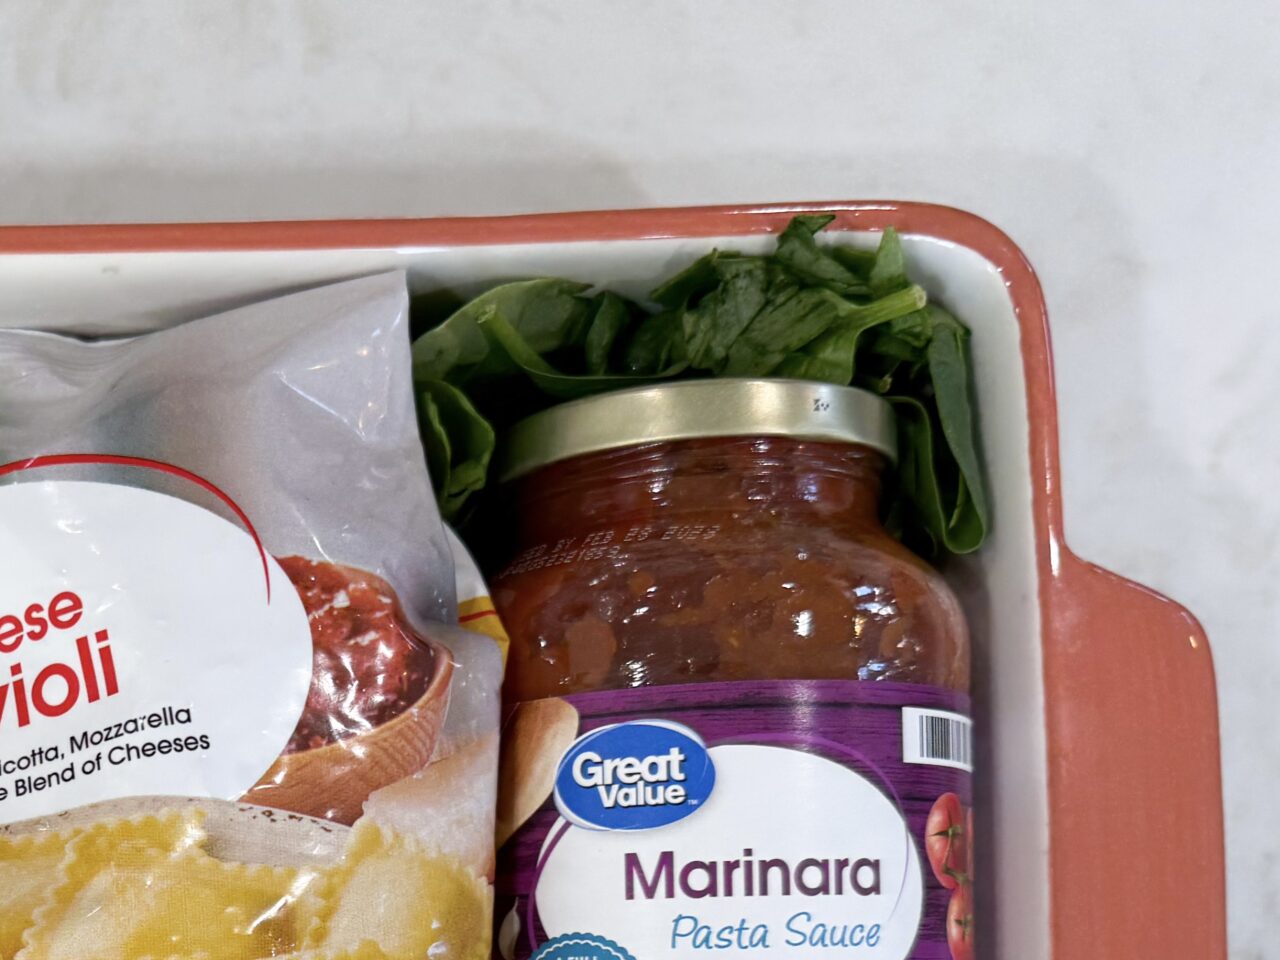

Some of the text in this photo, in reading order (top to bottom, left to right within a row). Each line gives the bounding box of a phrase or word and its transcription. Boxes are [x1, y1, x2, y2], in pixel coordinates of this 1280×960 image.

[582, 530, 615, 547] FEB
[69, 706, 192, 752] Mozzarella
[14, 766, 76, 797] Blend
[81, 754, 105, 777] of
[108, 732, 210, 766] Cheeses
[572, 746, 686, 788] Great
[598, 780, 687, 808] Value
[624, 848, 881, 900] Marinara
[670, 911, 881, 949] Pasta Sauce
